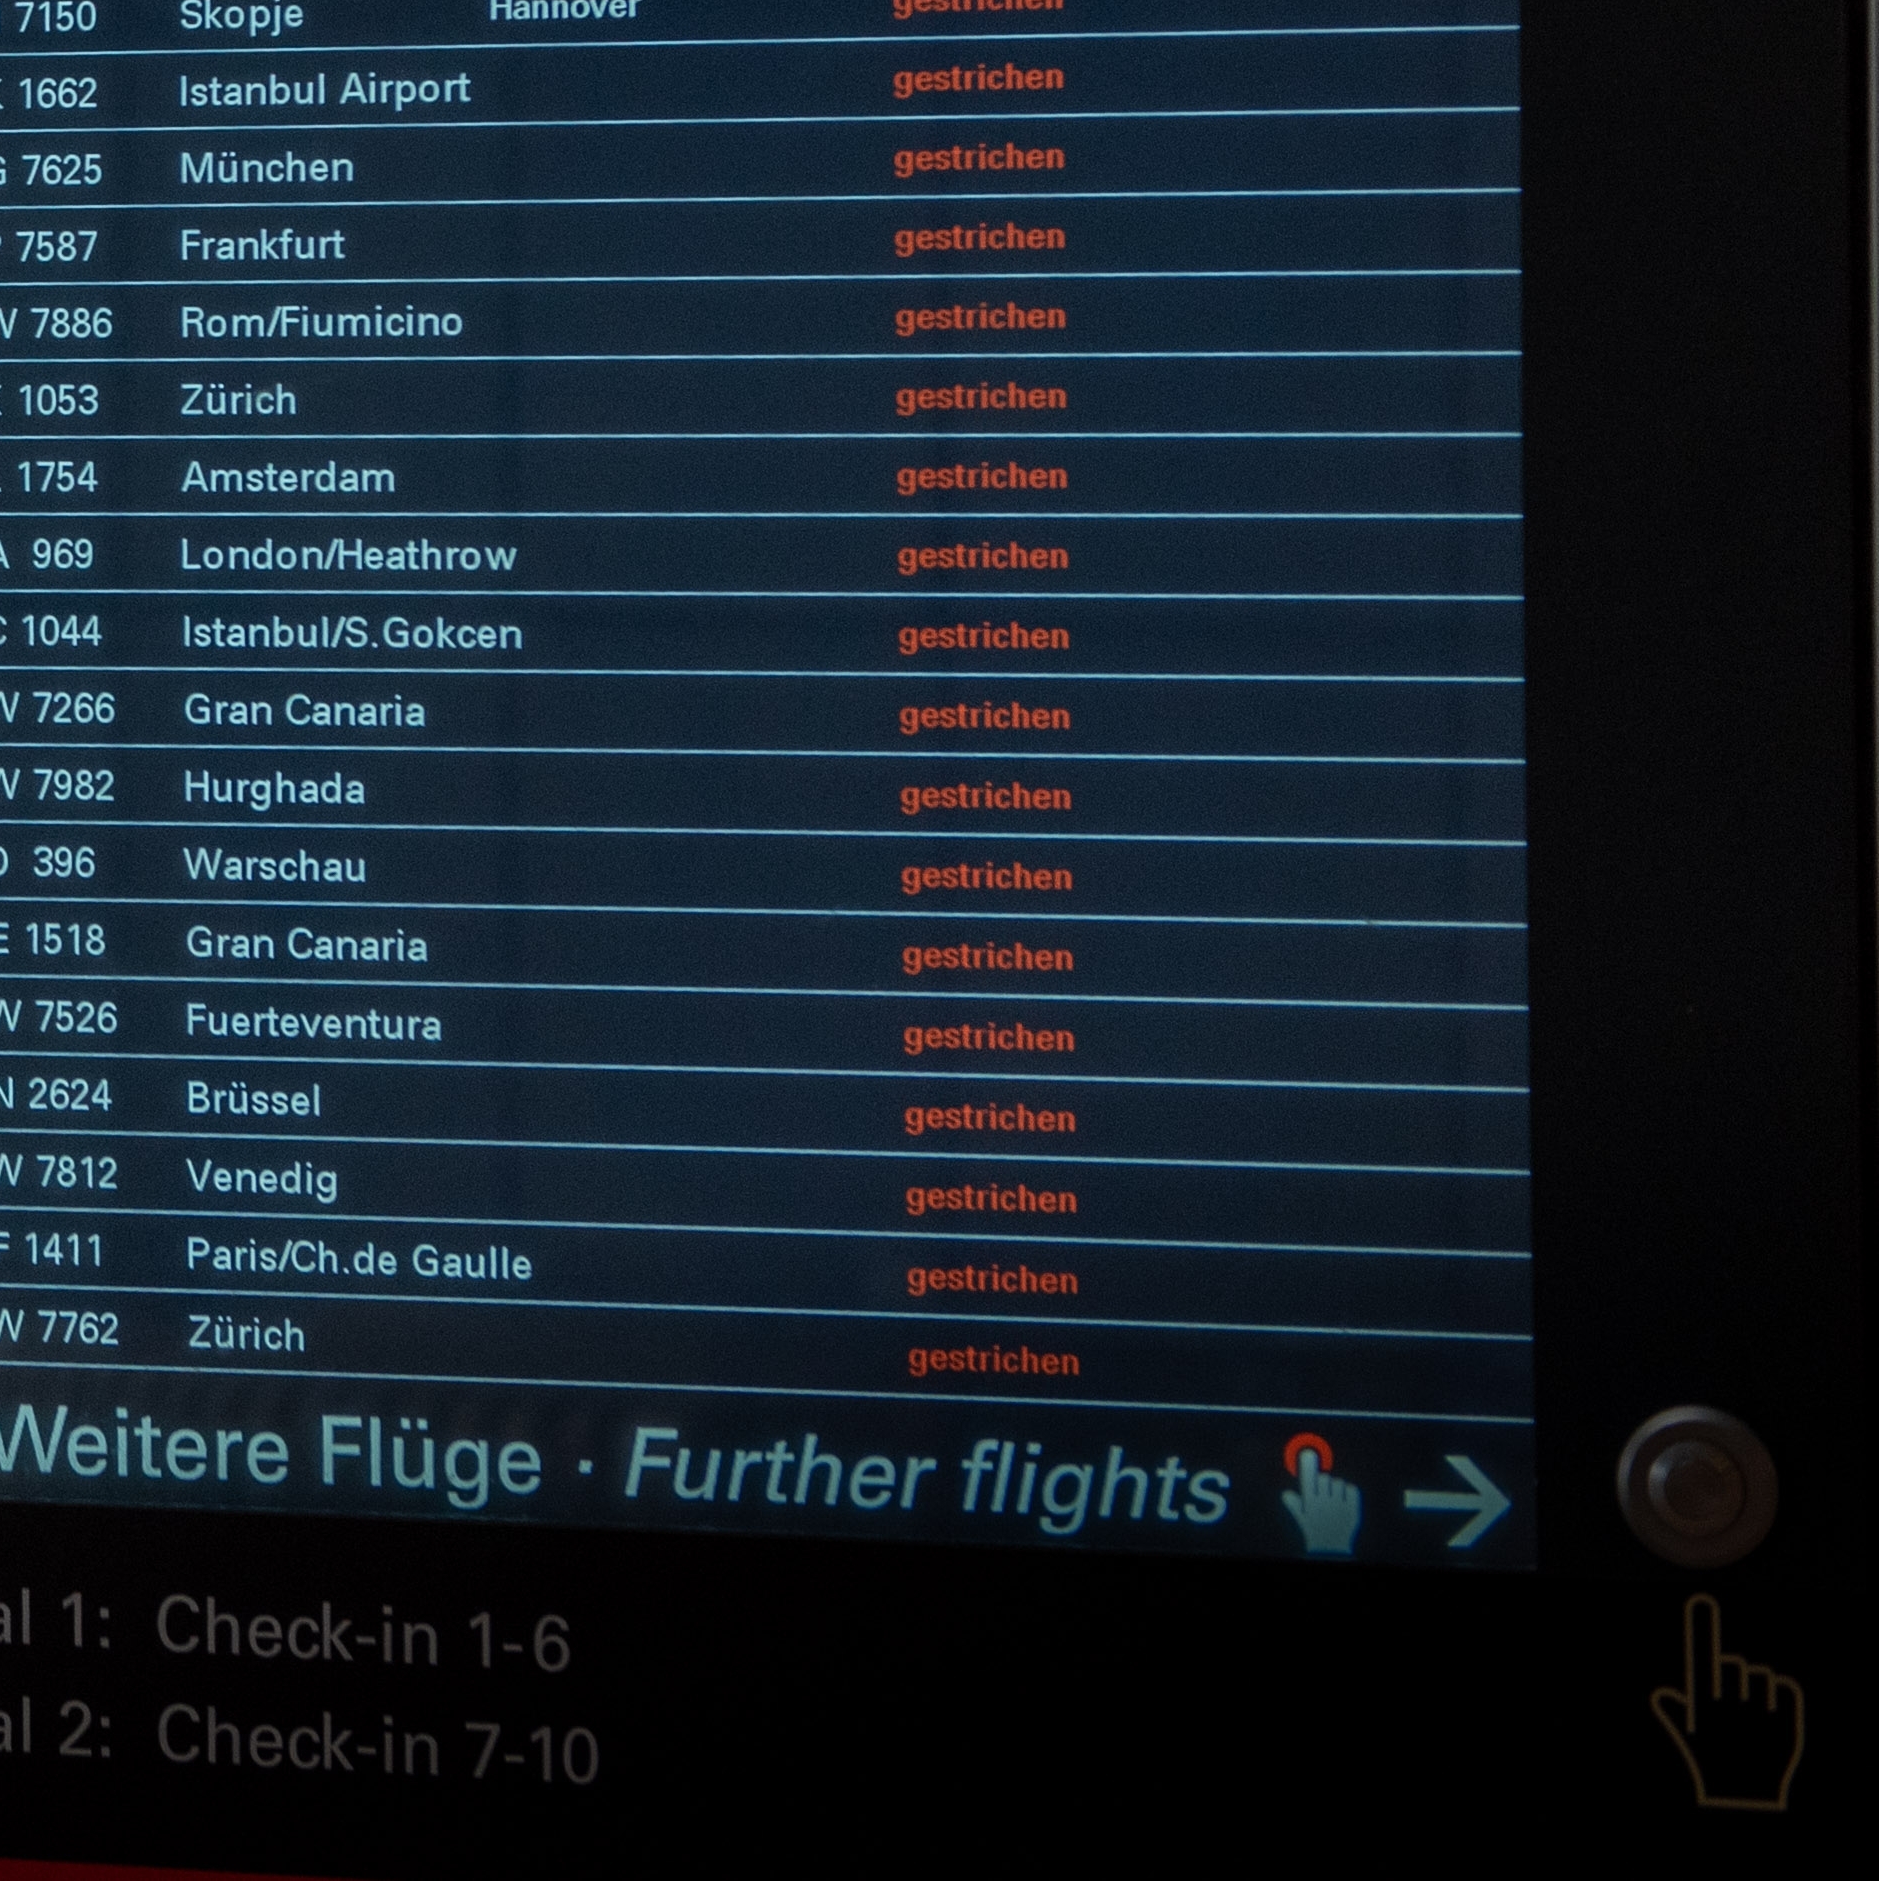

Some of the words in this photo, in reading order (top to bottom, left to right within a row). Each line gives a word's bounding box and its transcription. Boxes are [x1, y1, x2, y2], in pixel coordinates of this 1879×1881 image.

[13, 0, 98, 34] 7150
[18, 76, 98, 110] 1662
[179, 72, 326, 108] Istanbul
[338, 71, 472, 113] Airport
[893, 63, 1064, 99] gestrichen
[14, 229, 99, 263] 7587
[179, 227, 347, 262] Frankfurt
[894, 222, 1066, 257] gestrichen
[18, 382, 100, 417] 1053
[179, 382, 297, 417] Zürich
[896, 382, 1067, 416] gestrichen
[31, 537, 94, 571] 969
[180, 537, 518, 572] London/Heathrow
[897, 542, 1069, 575] gestrichen
[21, 613, 104, 648] 1044
[182, 614, 524, 650] Istanbul/S.Gokcen
[898, 621, 1070, 655] gestrichen
[31, 690, 116, 725] 7266
[183, 691, 274, 726] Gran
[284, 692, 427, 728] Canaria
[899, 702, 1071, 735] gestrichen
[25, 921, 107, 957] 1518
[185, 924, 276, 960] Gran
[286, 926, 429, 963] Canaria
[902, 942, 1074, 975] gestrichen
[34, 999, 119, 1035] 7526
[185, 1001, 443, 1043] Fuerteventura
[903, 1023, 1075, 1055] gestrichen
[24, 1231, 102, 1268] 1411
[186, 1235, 398, 1277] Paris/Ch.de
[411, 1243, 533, 1282] Gaulle
[907, 1265, 1078, 1296] gestrichen
[36, 1309, 120, 1347] 7762
[187, 1313, 306, 1353] Zürich
[909, 1347, 1079, 1375] gestrichen
[320, 1413, 542, 1510] Flüge
[625, 1426, 937, 1509] Further
[960, 1438, 1233, 1534] flights
[61, 1590, 111, 1649] 1:
[155, 1592, 438, 1666] Check-in
[469, 1611, 571, 1672] 1-6
[58, 1698, 111, 1758] 2:
[157, 1702, 438, 1774] Check-in
[463, 1718, 600, 1782] 7-10
